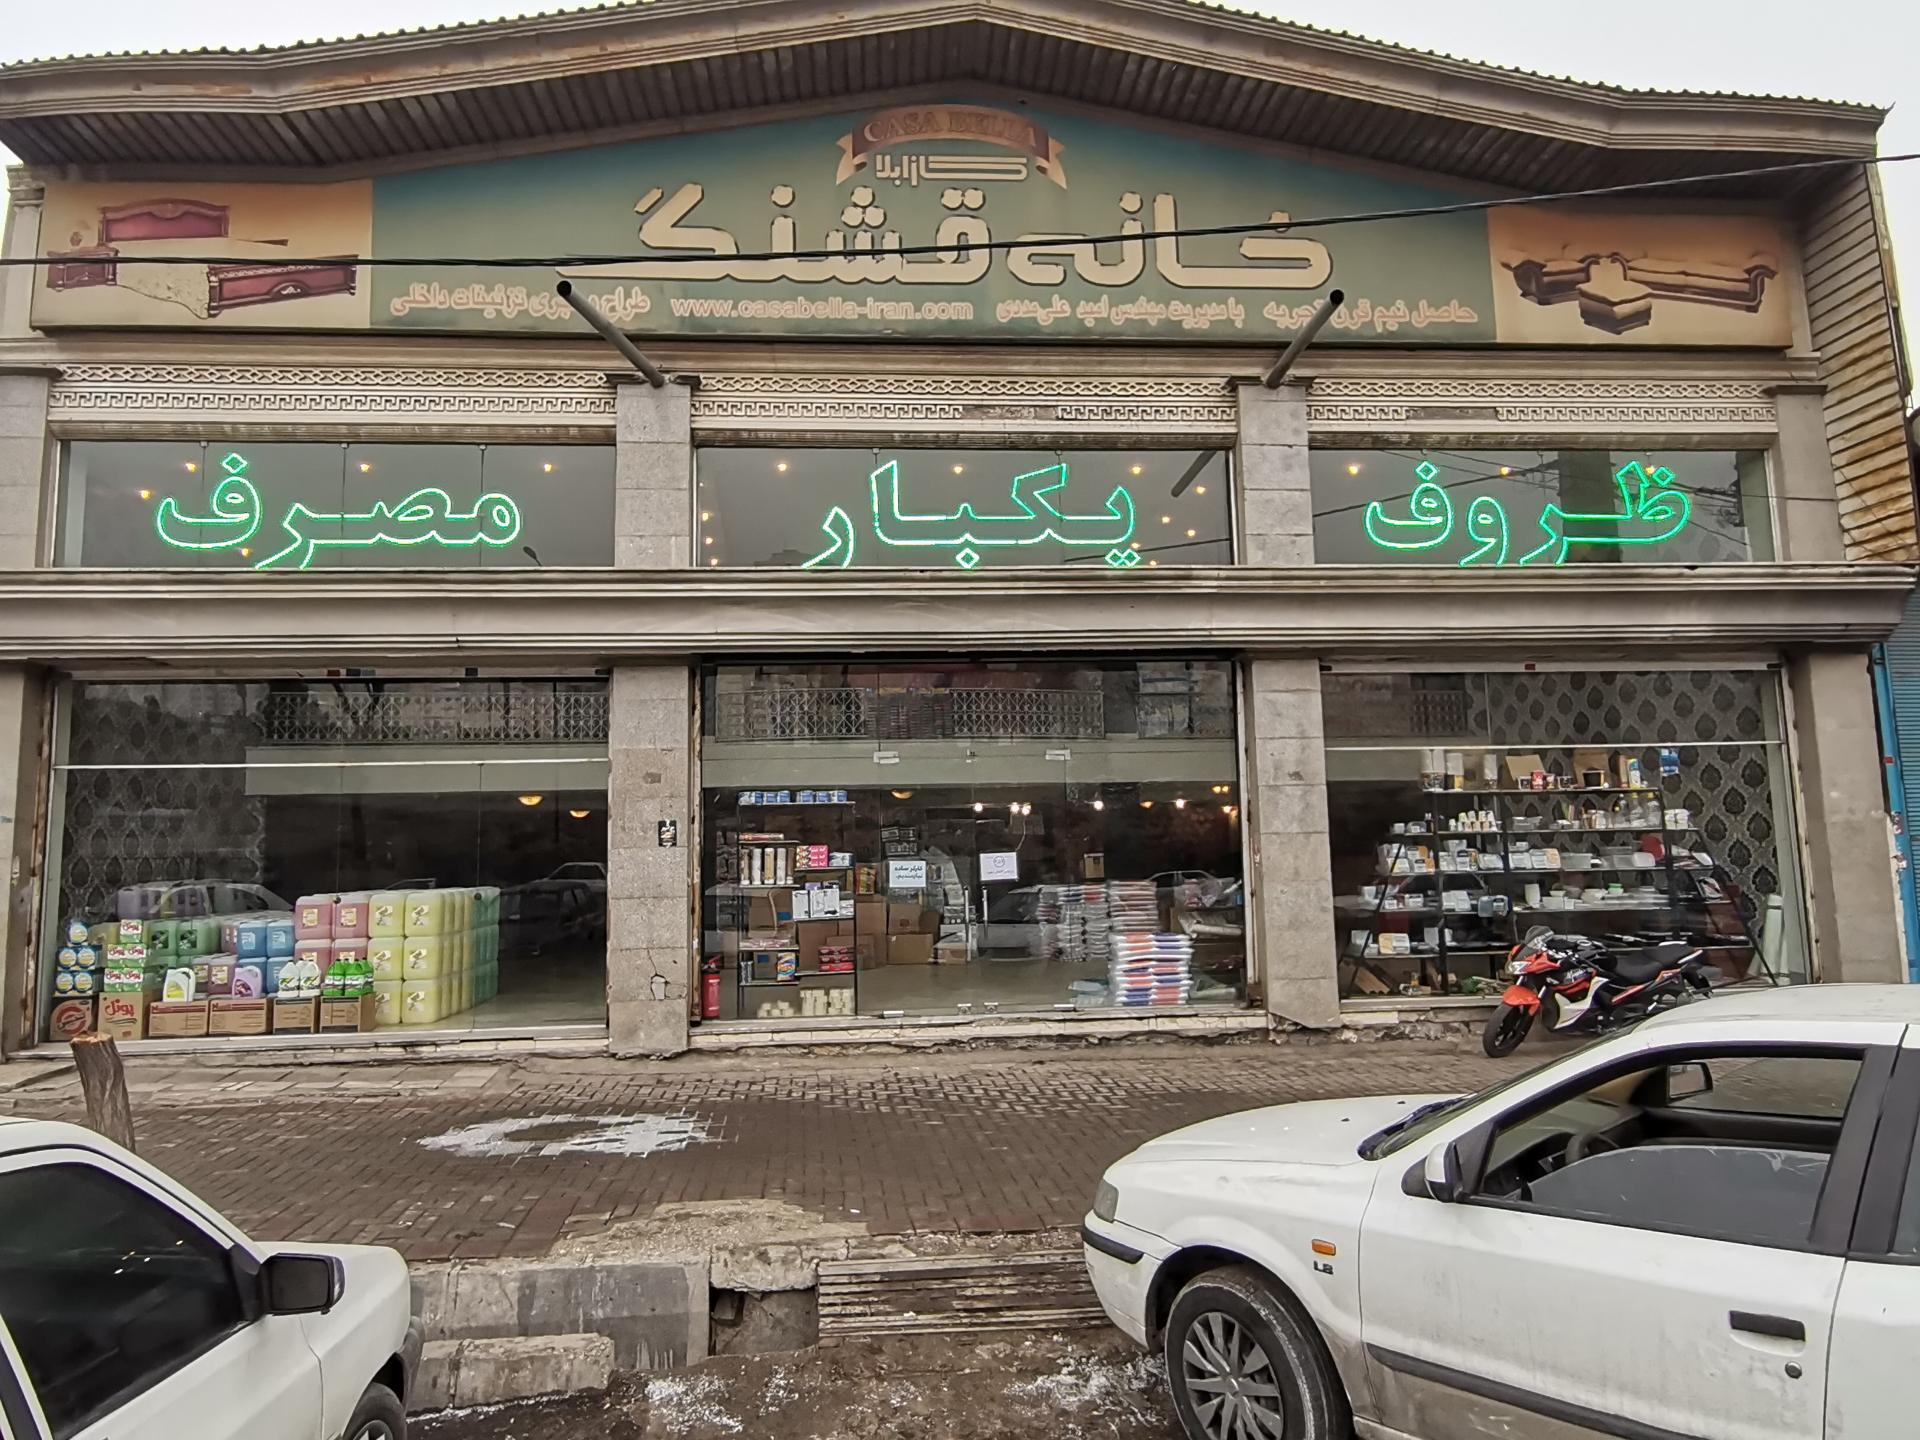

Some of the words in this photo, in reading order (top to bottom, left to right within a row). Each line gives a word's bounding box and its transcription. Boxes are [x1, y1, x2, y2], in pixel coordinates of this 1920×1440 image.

[863, 111, 941, 142] CASA
[875, 154, 1028, 187] کازابلا
[555, 183, 992, 285] قشنگ
[1006, 191, 1332, 289] خانه
[390, 282, 449, 316] داخلی
[601, 286, 651, 321] طراح
[670, 296, 974, 319] www.casabella-iran.com
[1374, 299, 1409, 333] نیم
[1411, 299, 1478, 328] حاصل
[156, 452, 522, 570] مصرف
[801, 459, 1141, 569] یکبار
[1364, 460, 1690, 567] ظروف
